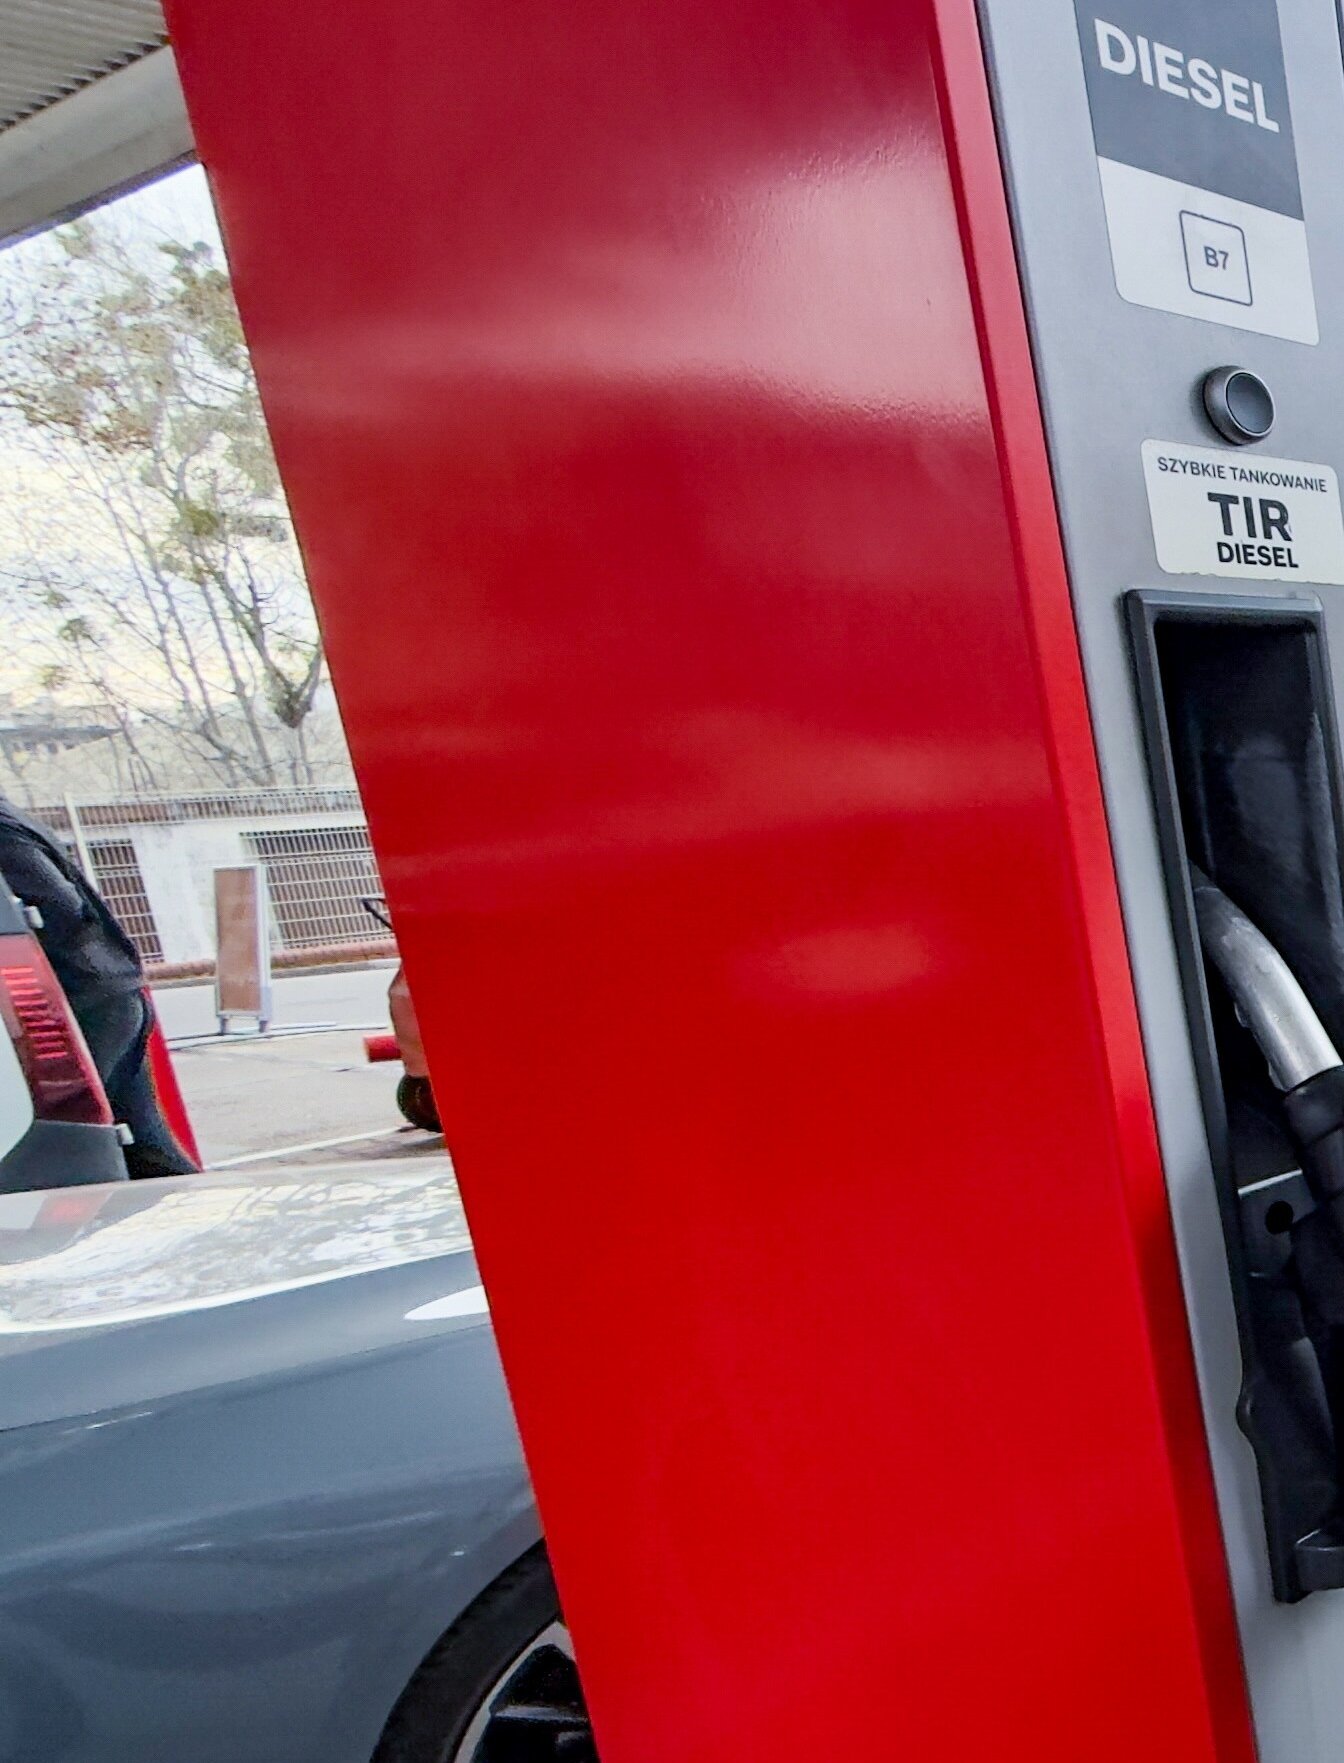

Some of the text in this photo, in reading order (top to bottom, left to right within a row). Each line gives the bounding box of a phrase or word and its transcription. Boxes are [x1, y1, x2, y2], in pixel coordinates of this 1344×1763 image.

[1094, 18, 1280, 134] DIESEL
[1203, 245, 1230, 272] B7
[1157, 456, 1328, 493] SZYBKIE TANKOWANIE
[1207, 492, 1293, 542] TIR
[1217, 542, 1299, 569] DIESEL
